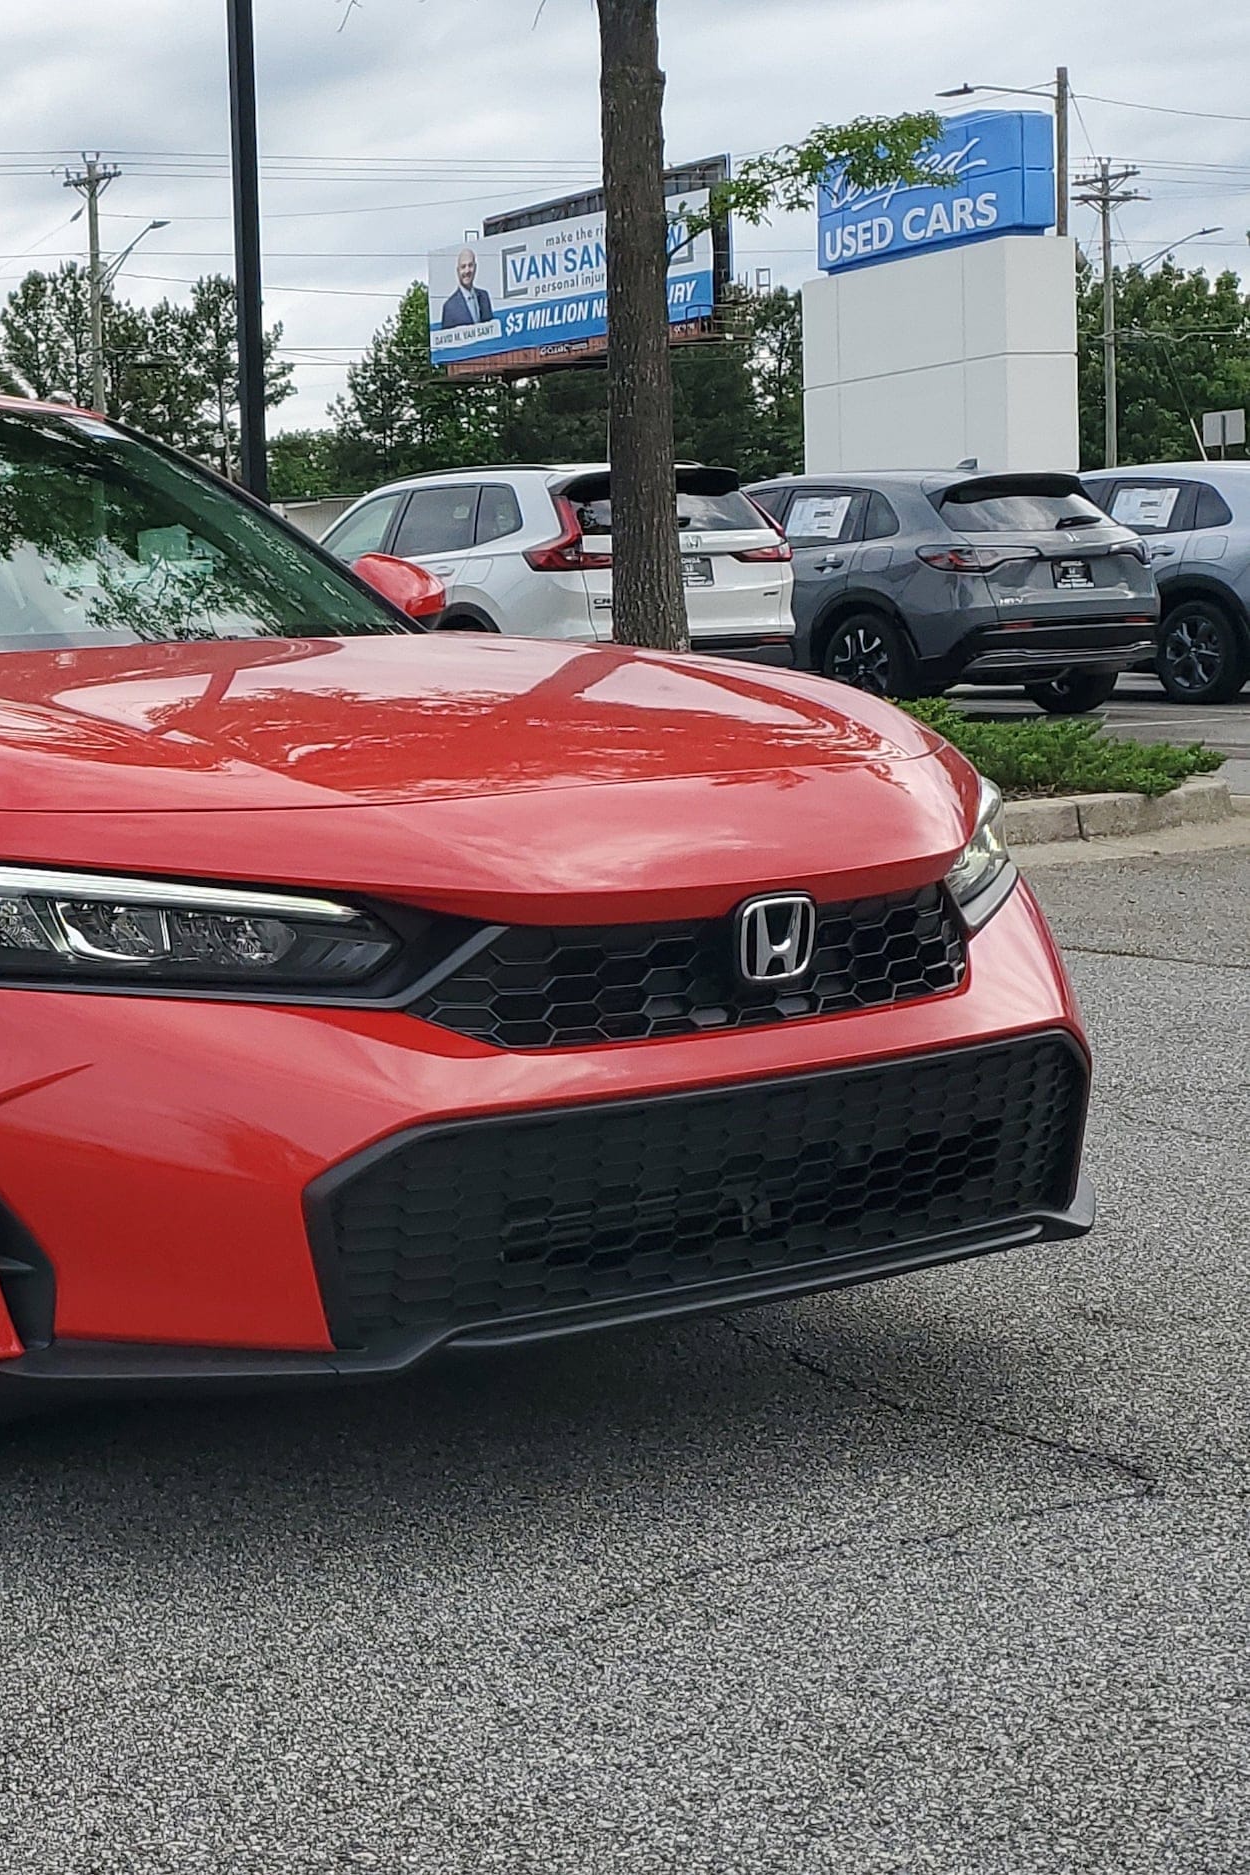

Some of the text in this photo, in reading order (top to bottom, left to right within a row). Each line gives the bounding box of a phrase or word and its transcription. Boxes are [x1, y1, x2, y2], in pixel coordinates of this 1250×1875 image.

[545, 231, 573, 247] make
[576, 226, 593, 241] the
[825, 192, 998, 262] USED CARS
[510, 242, 608, 283] VAN SAN
[534, 271, 605, 296] personal injur
[505, 312, 524, 337] $3
[527, 299, 589, 330] MILLION
